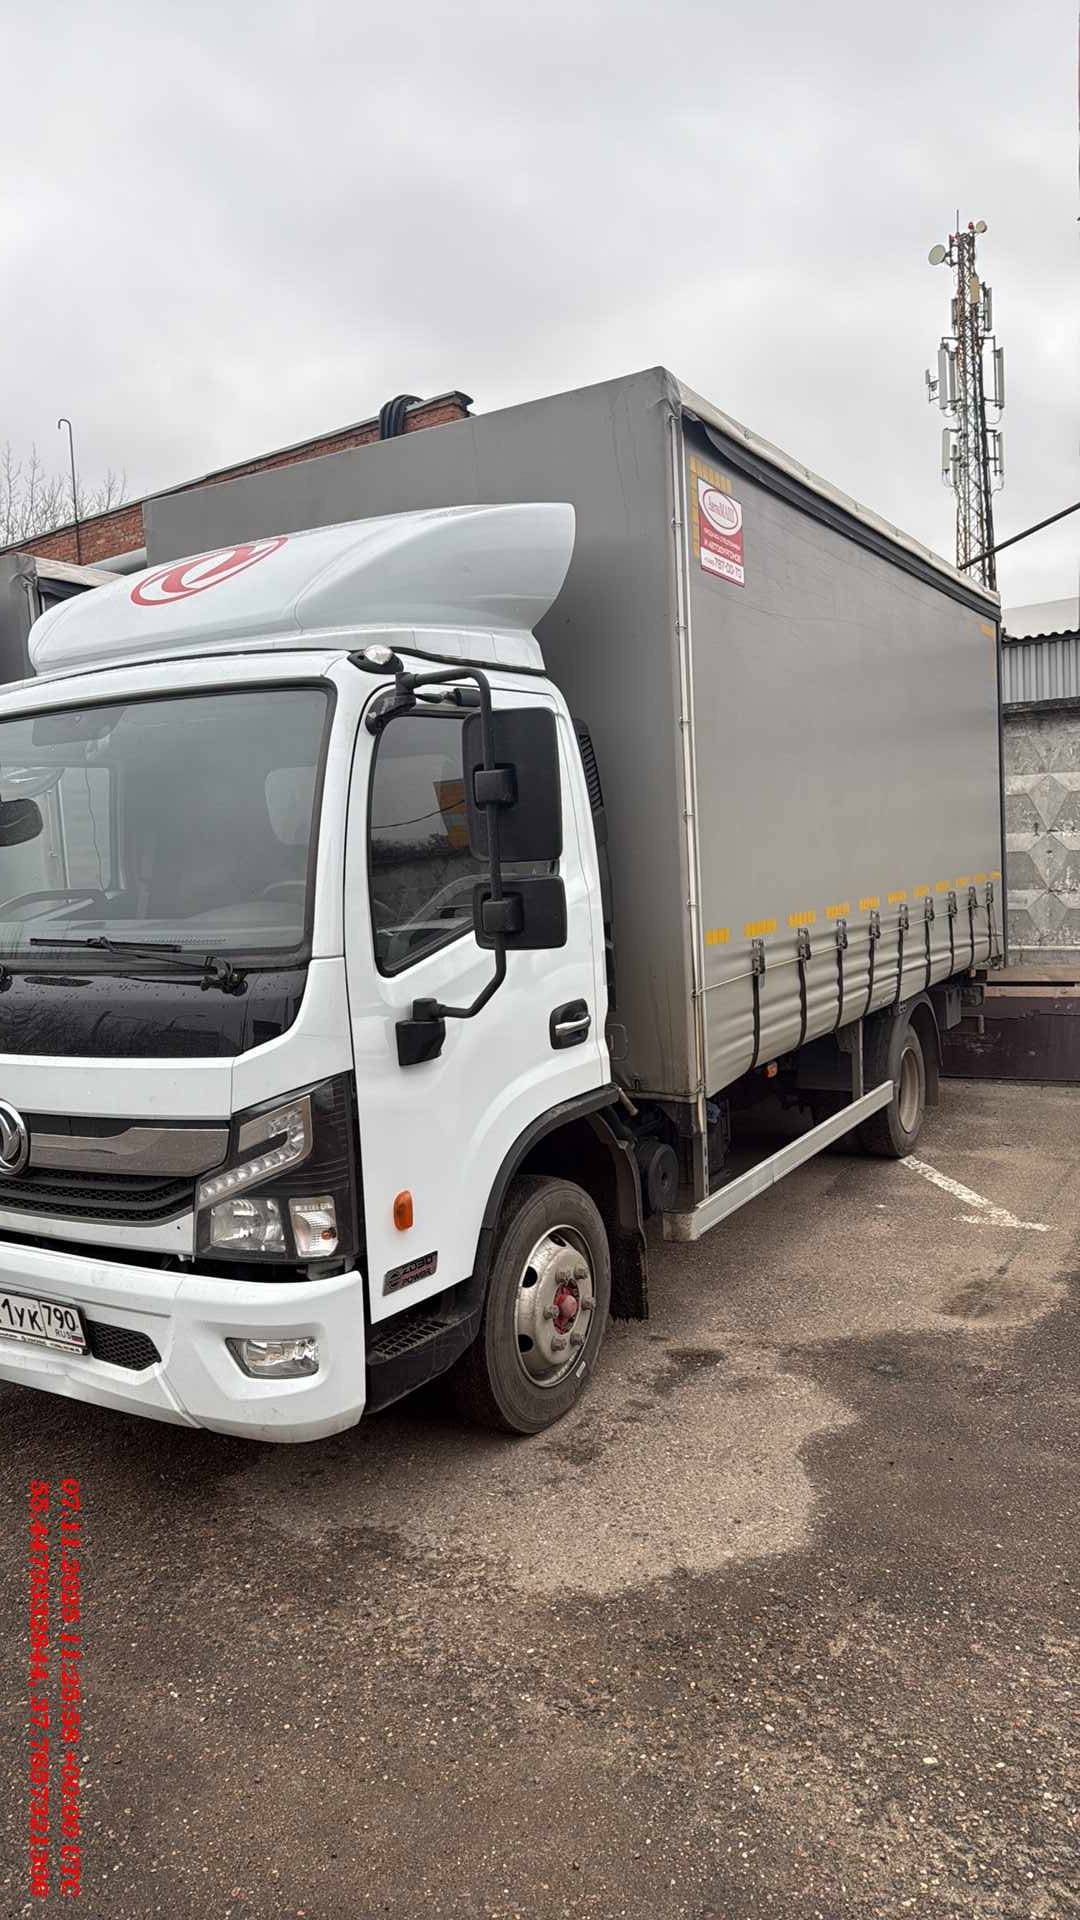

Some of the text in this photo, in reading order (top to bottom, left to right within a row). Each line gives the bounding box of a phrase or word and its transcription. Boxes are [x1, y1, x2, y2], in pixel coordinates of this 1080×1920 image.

[0, 1298, 76, 1332] 1УК 790
[55, 1328, 72, 1340] RUS
